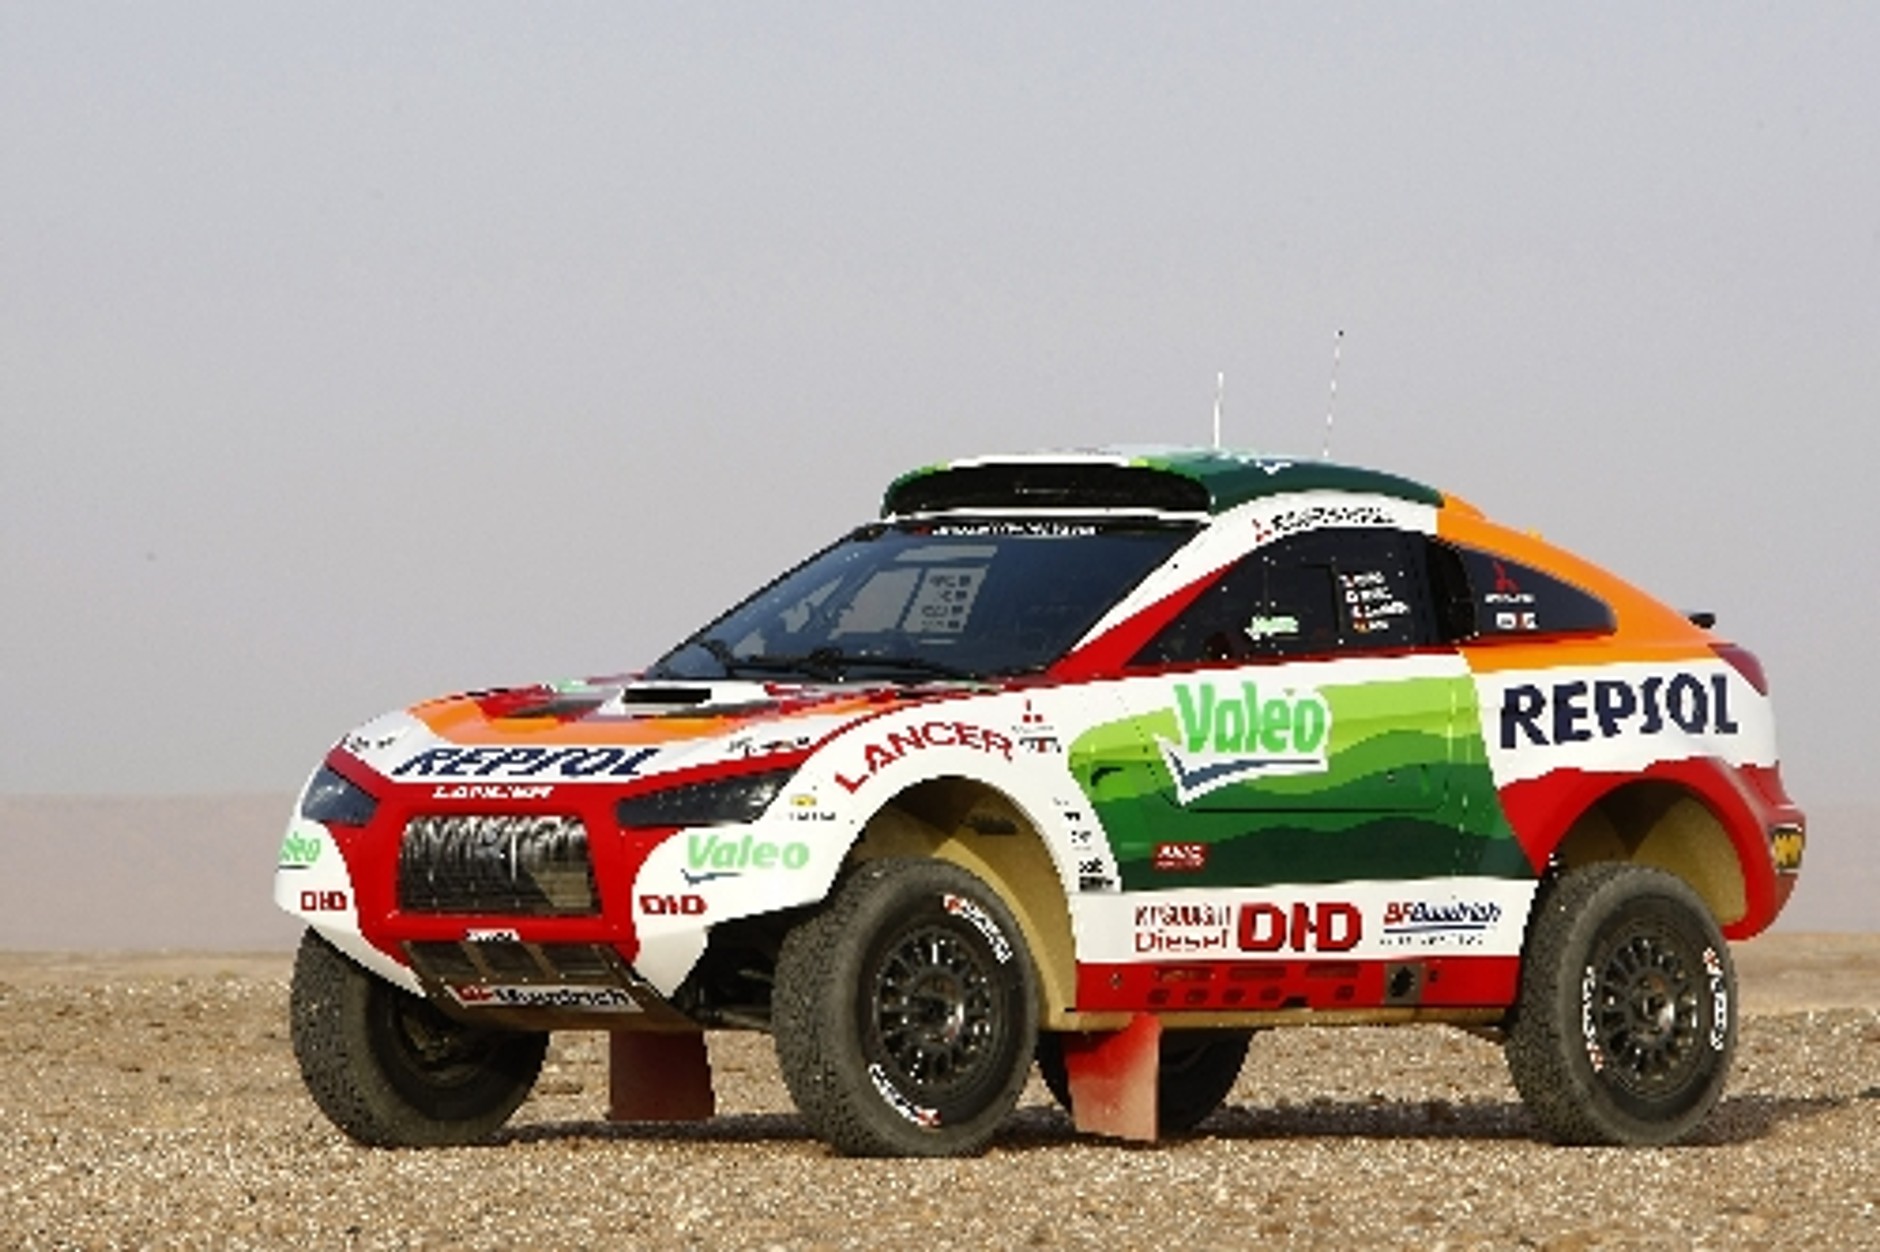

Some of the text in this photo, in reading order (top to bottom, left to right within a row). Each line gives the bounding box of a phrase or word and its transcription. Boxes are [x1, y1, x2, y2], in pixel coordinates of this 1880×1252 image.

[1173, 681, 1325, 754] Valeo
[1500, 673, 1739, 750] REPSOL
[391, 748, 660, 776] REPSOL
[835, 721, 1013, 794] LANCER
[687, 834, 810, 870] Valeo
[1135, 928, 1229, 953] Diesel
